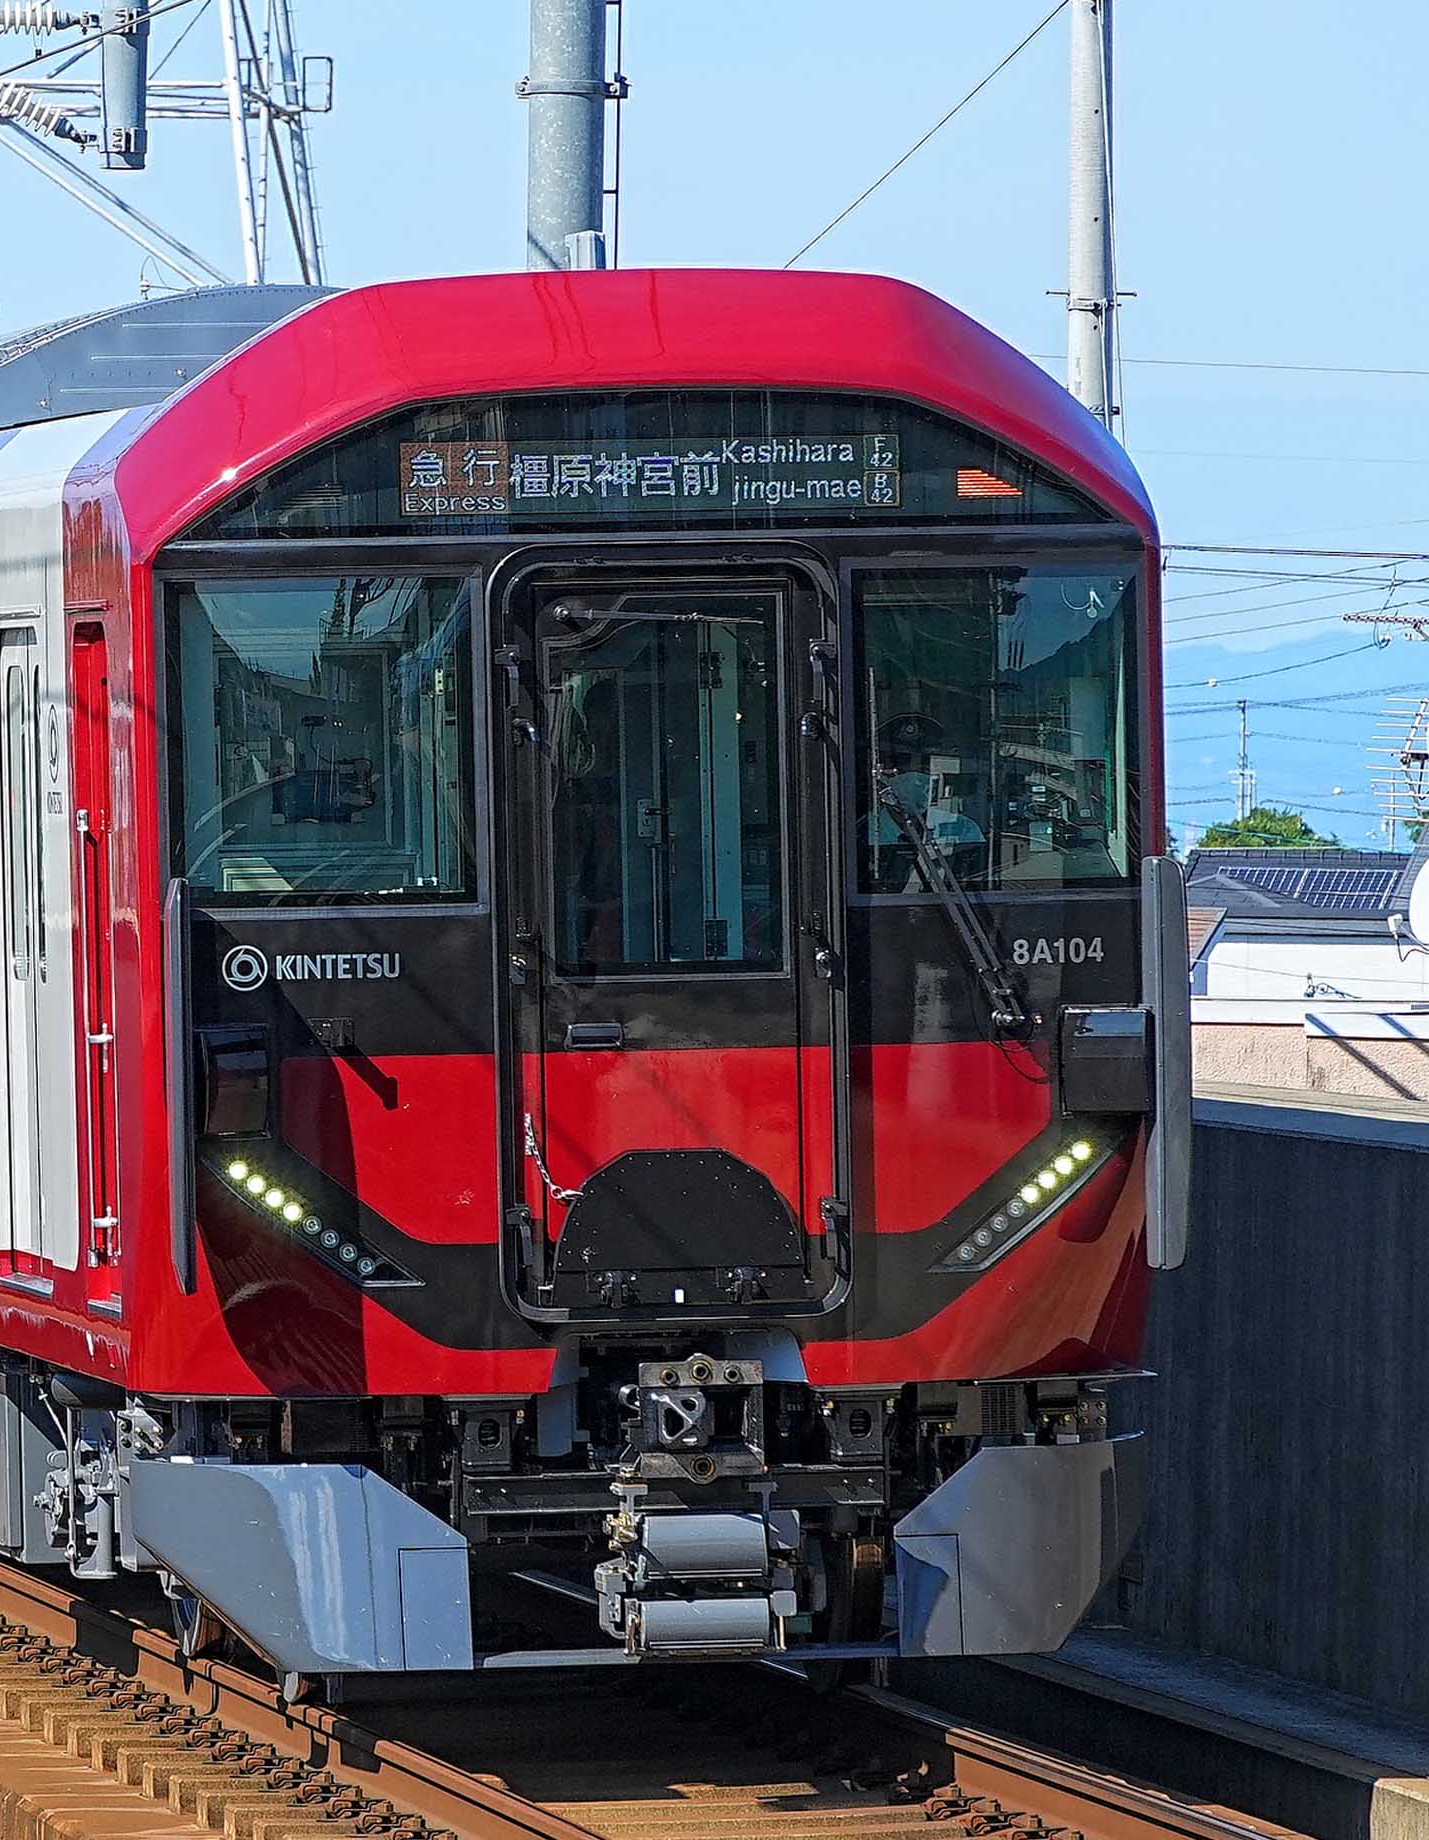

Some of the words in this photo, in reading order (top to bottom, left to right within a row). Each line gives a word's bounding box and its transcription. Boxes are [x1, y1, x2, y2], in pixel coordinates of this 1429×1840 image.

[722, 439, 854, 464] Kashihara
[874, 437, 886, 452] F
[409, 449, 500, 488] 急行
[870, 452, 892, 467] 42
[509, 452, 721, 499] 橿原神宮前
[874, 473, 887, 488] B
[732, 476, 862, 506] jingu-mae
[871, 488, 893, 503] 42
[405, 493, 505, 515] Express
[1012, 937, 1104, 965] 8A104
[276, 953, 400, 980] KINTETSU
